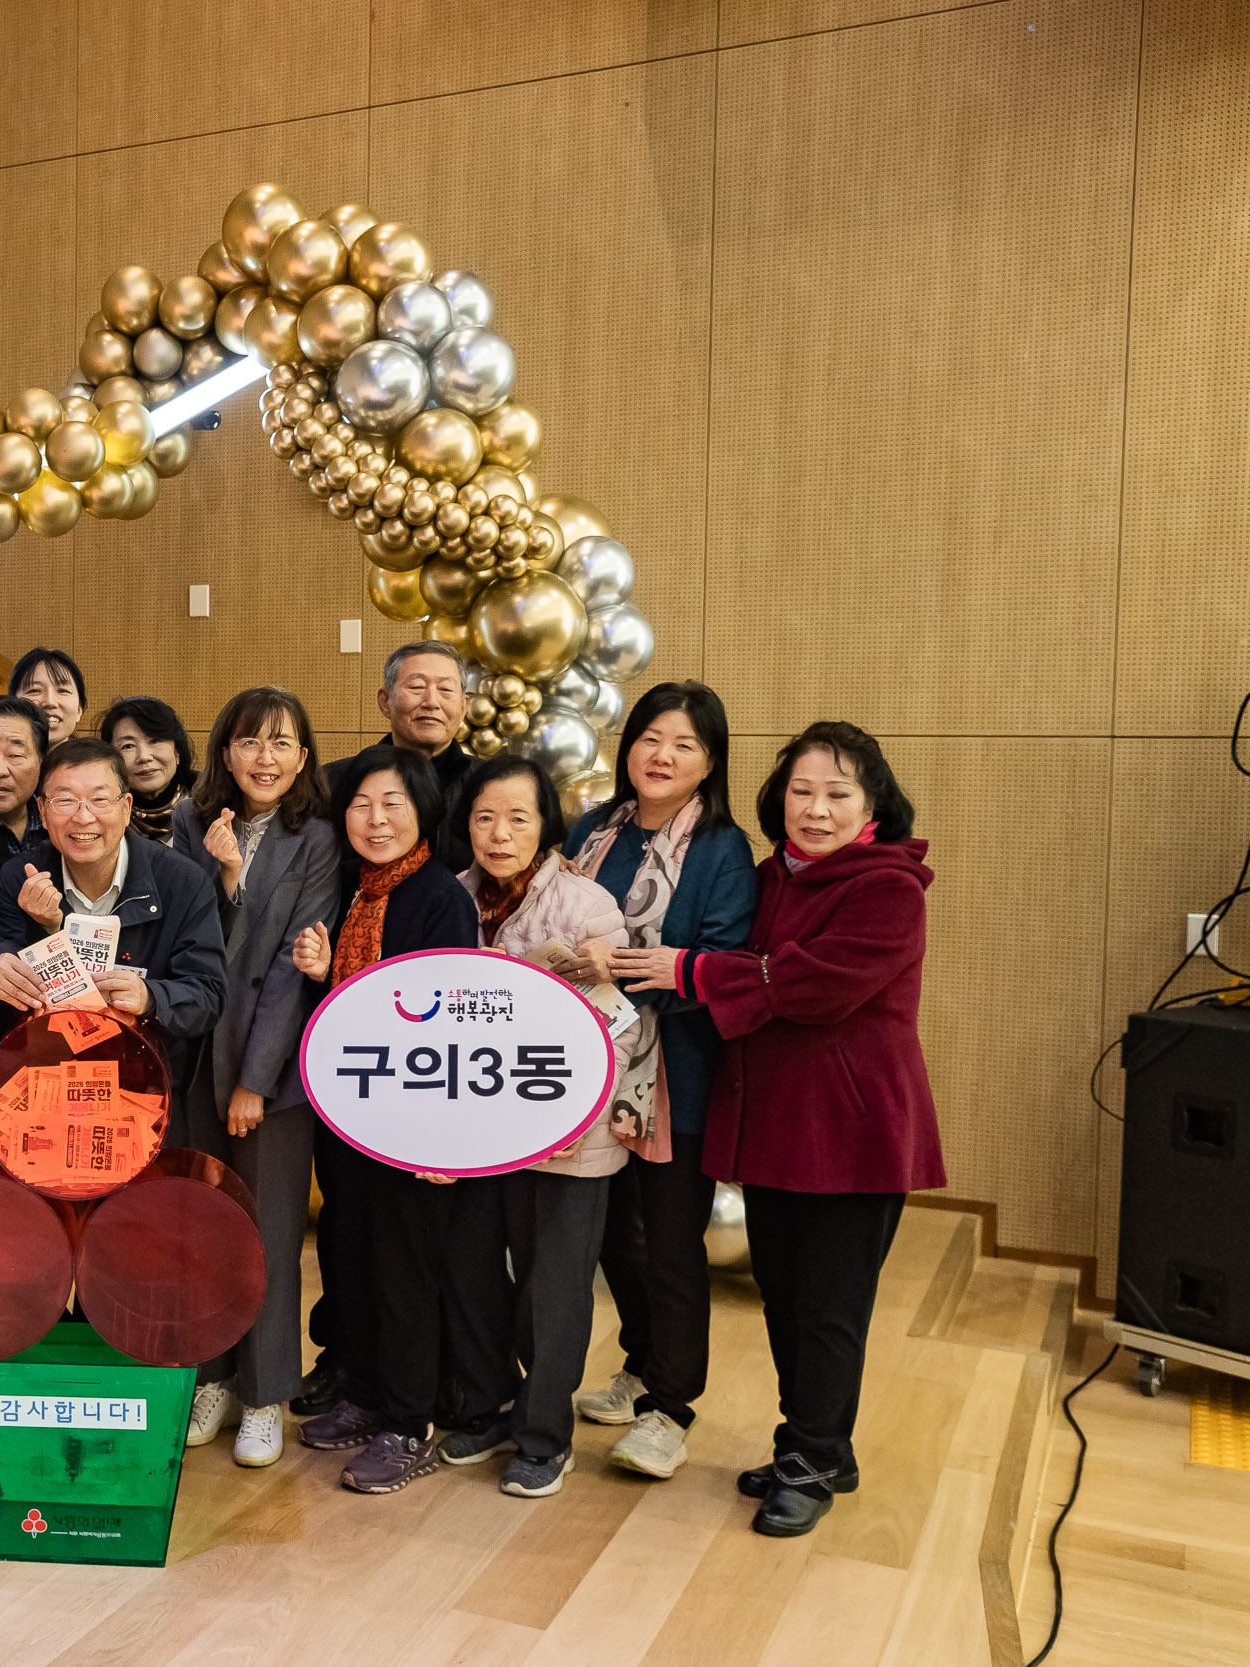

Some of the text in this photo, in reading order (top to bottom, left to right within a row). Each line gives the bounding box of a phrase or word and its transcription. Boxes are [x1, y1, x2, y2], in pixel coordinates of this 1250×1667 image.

[447, 988, 514, 1003] 소통하며 발전하는
[447, 1000, 513, 1024] 행복광진
[336, 1043, 573, 1102] 구의3동
[67, 1088, 112, 1102] 따뜻한
[0, 1400, 142, 1424] 감사합니다!
